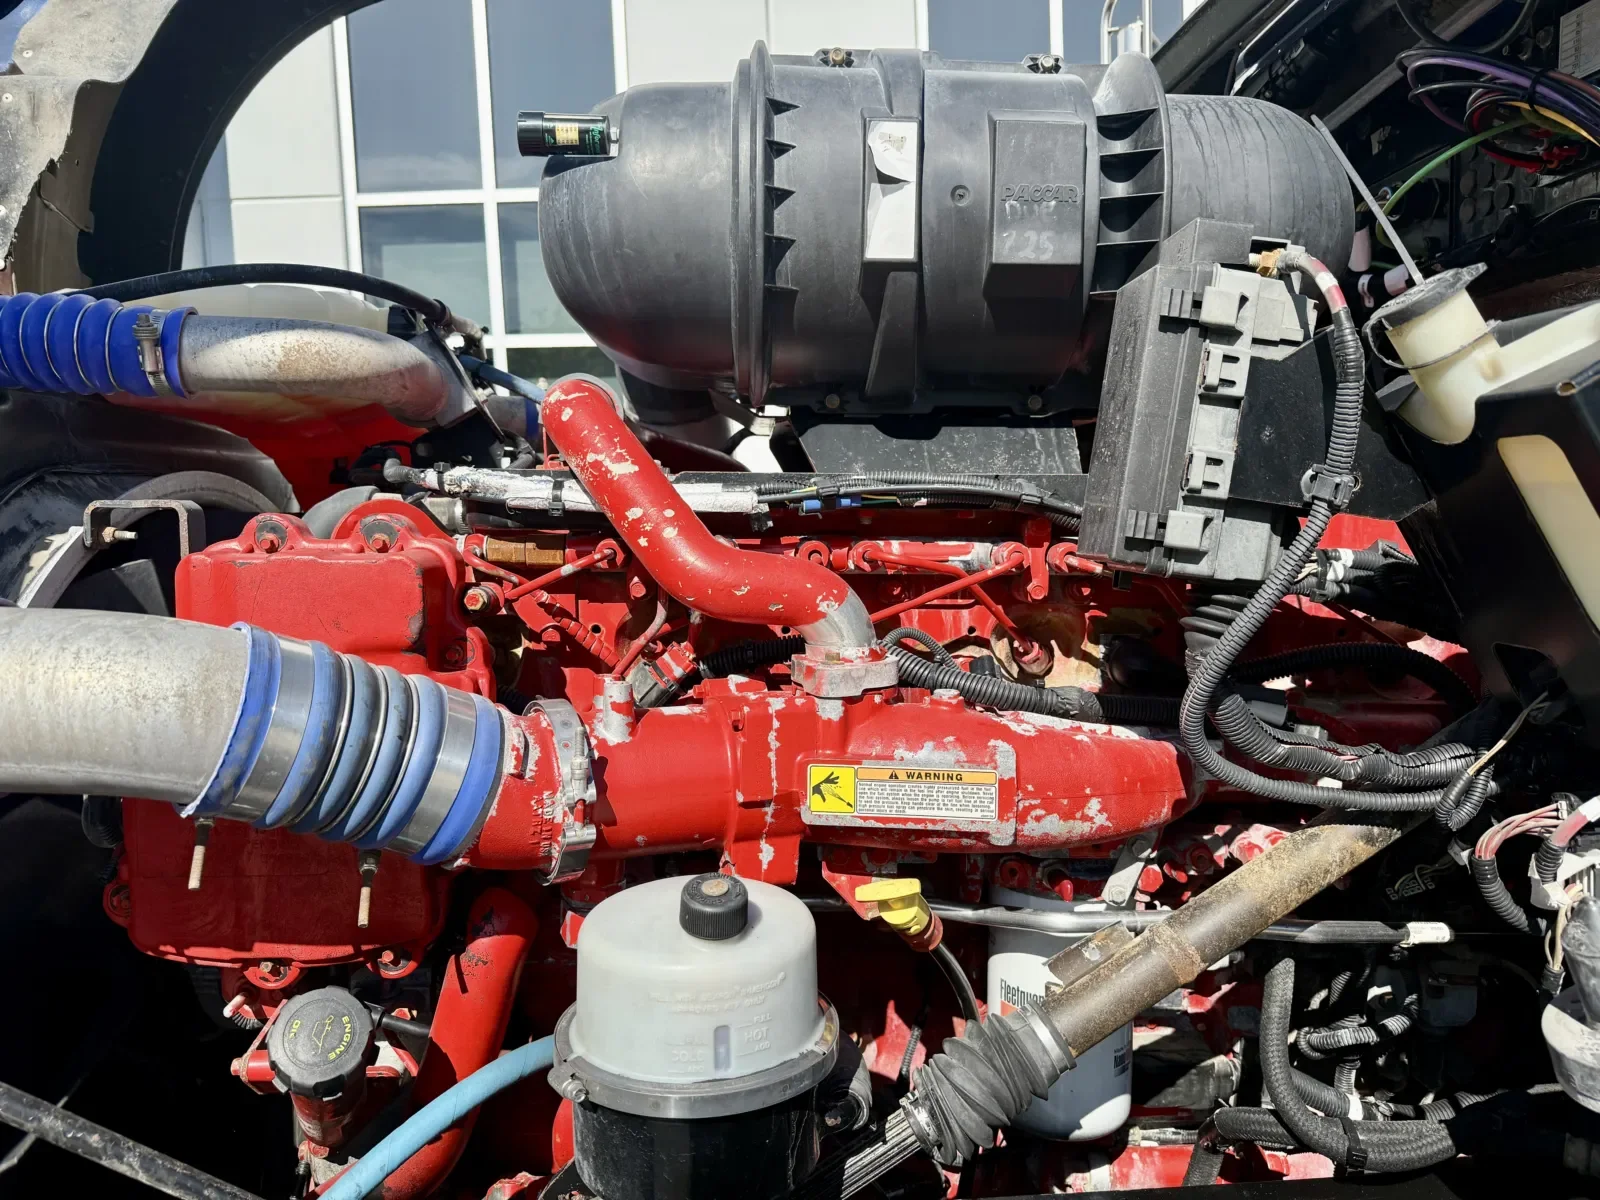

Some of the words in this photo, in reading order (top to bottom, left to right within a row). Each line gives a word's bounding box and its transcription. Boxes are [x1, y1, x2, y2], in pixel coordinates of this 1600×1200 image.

[1001, 184, 1079, 203] PACCAR
[906, 771, 963, 781] WARNING
[543, 790, 555, 824] MADE
[328, 1015, 351, 1061] ENGINE
[744, 1026, 769, 1042] HOT
